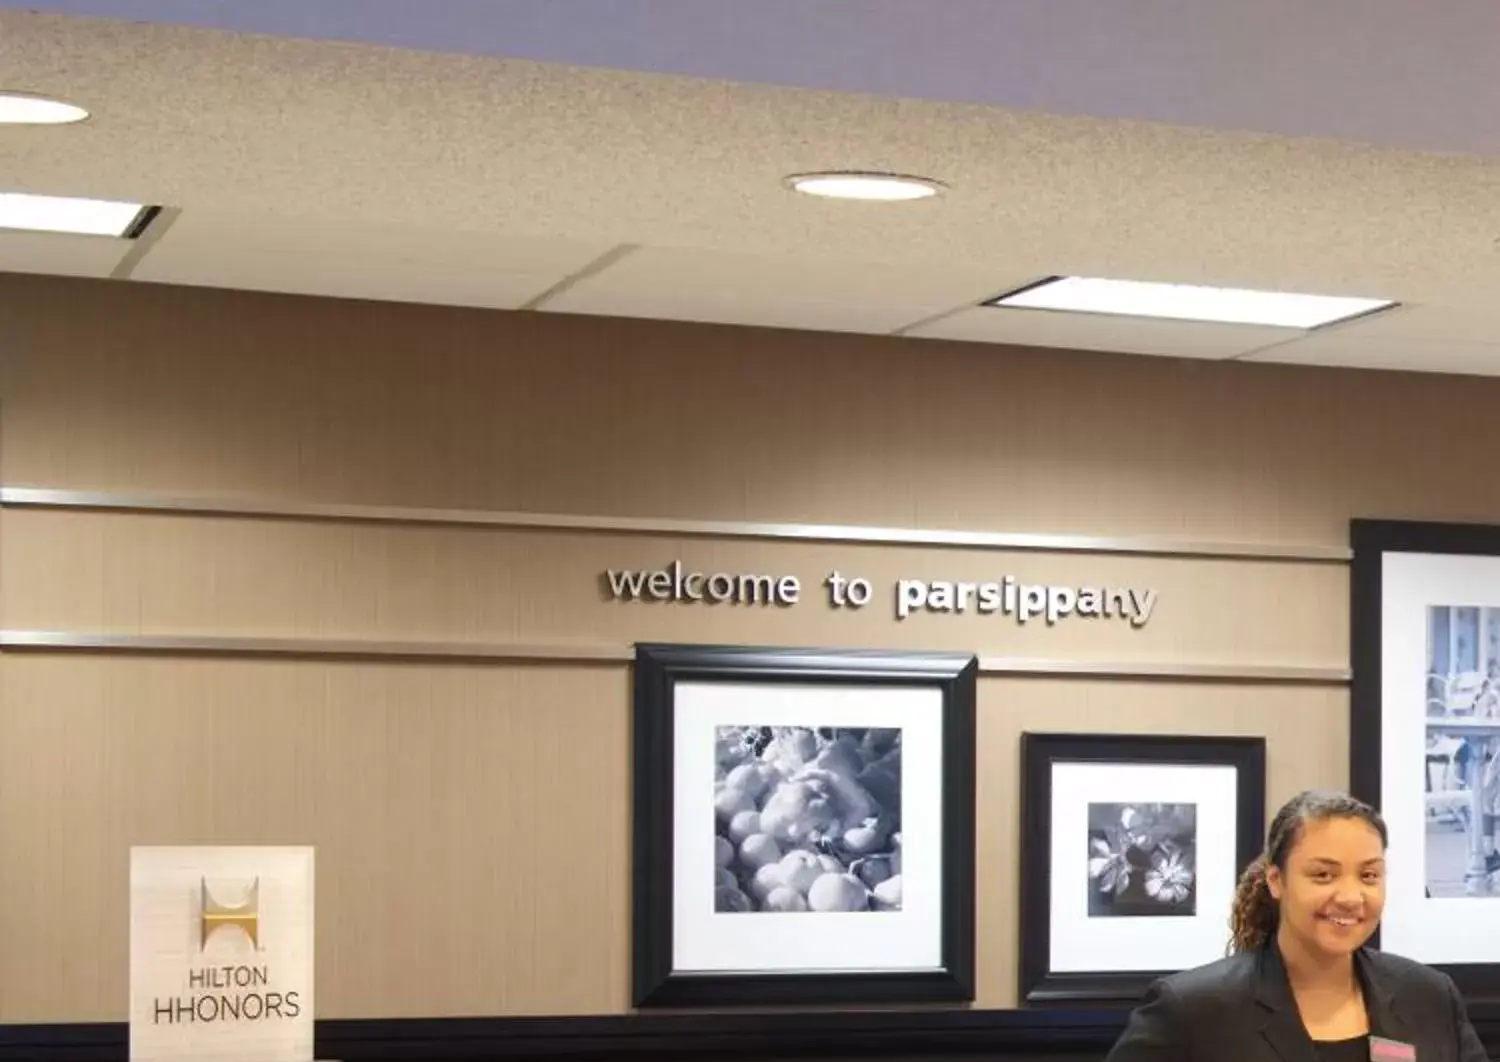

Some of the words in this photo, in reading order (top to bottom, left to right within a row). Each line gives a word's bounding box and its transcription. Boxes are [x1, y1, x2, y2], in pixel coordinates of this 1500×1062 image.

[605, 559, 800, 605] welcome
[826, 570, 872, 607] to
[896, 575, 1159, 625] parsippany
[188, 964, 269, 989] HILTON
[153, 990, 301, 1024] HHONORS
